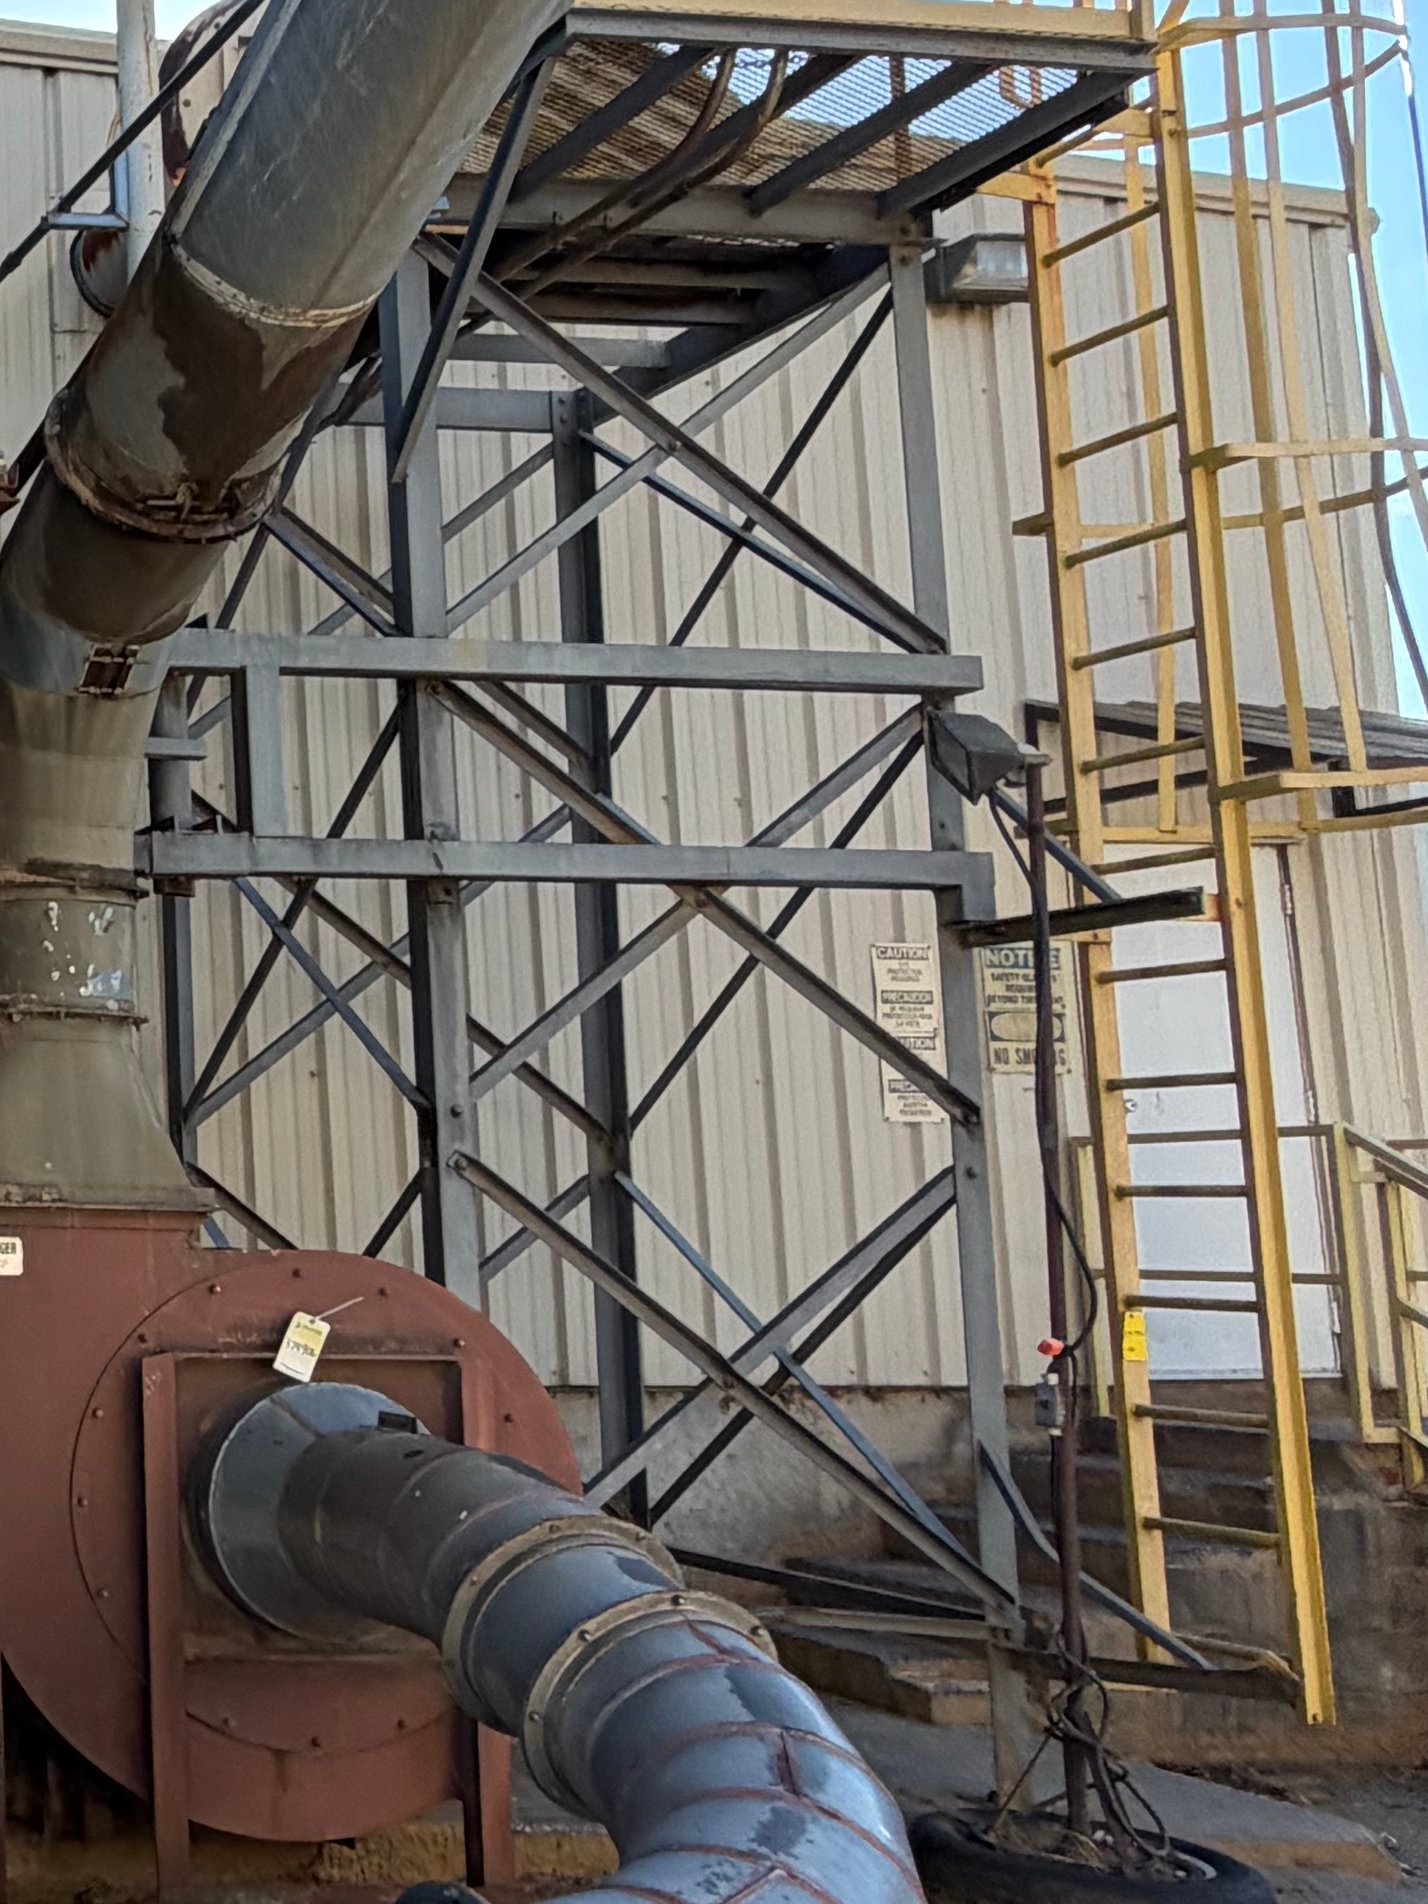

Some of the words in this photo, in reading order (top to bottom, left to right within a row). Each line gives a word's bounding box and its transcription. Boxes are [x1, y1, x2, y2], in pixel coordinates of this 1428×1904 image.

[985, 949, 1060, 970] NOTIE
[899, 1038, 935, 1049] UTION
[993, 1047, 1010, 1065] NO
